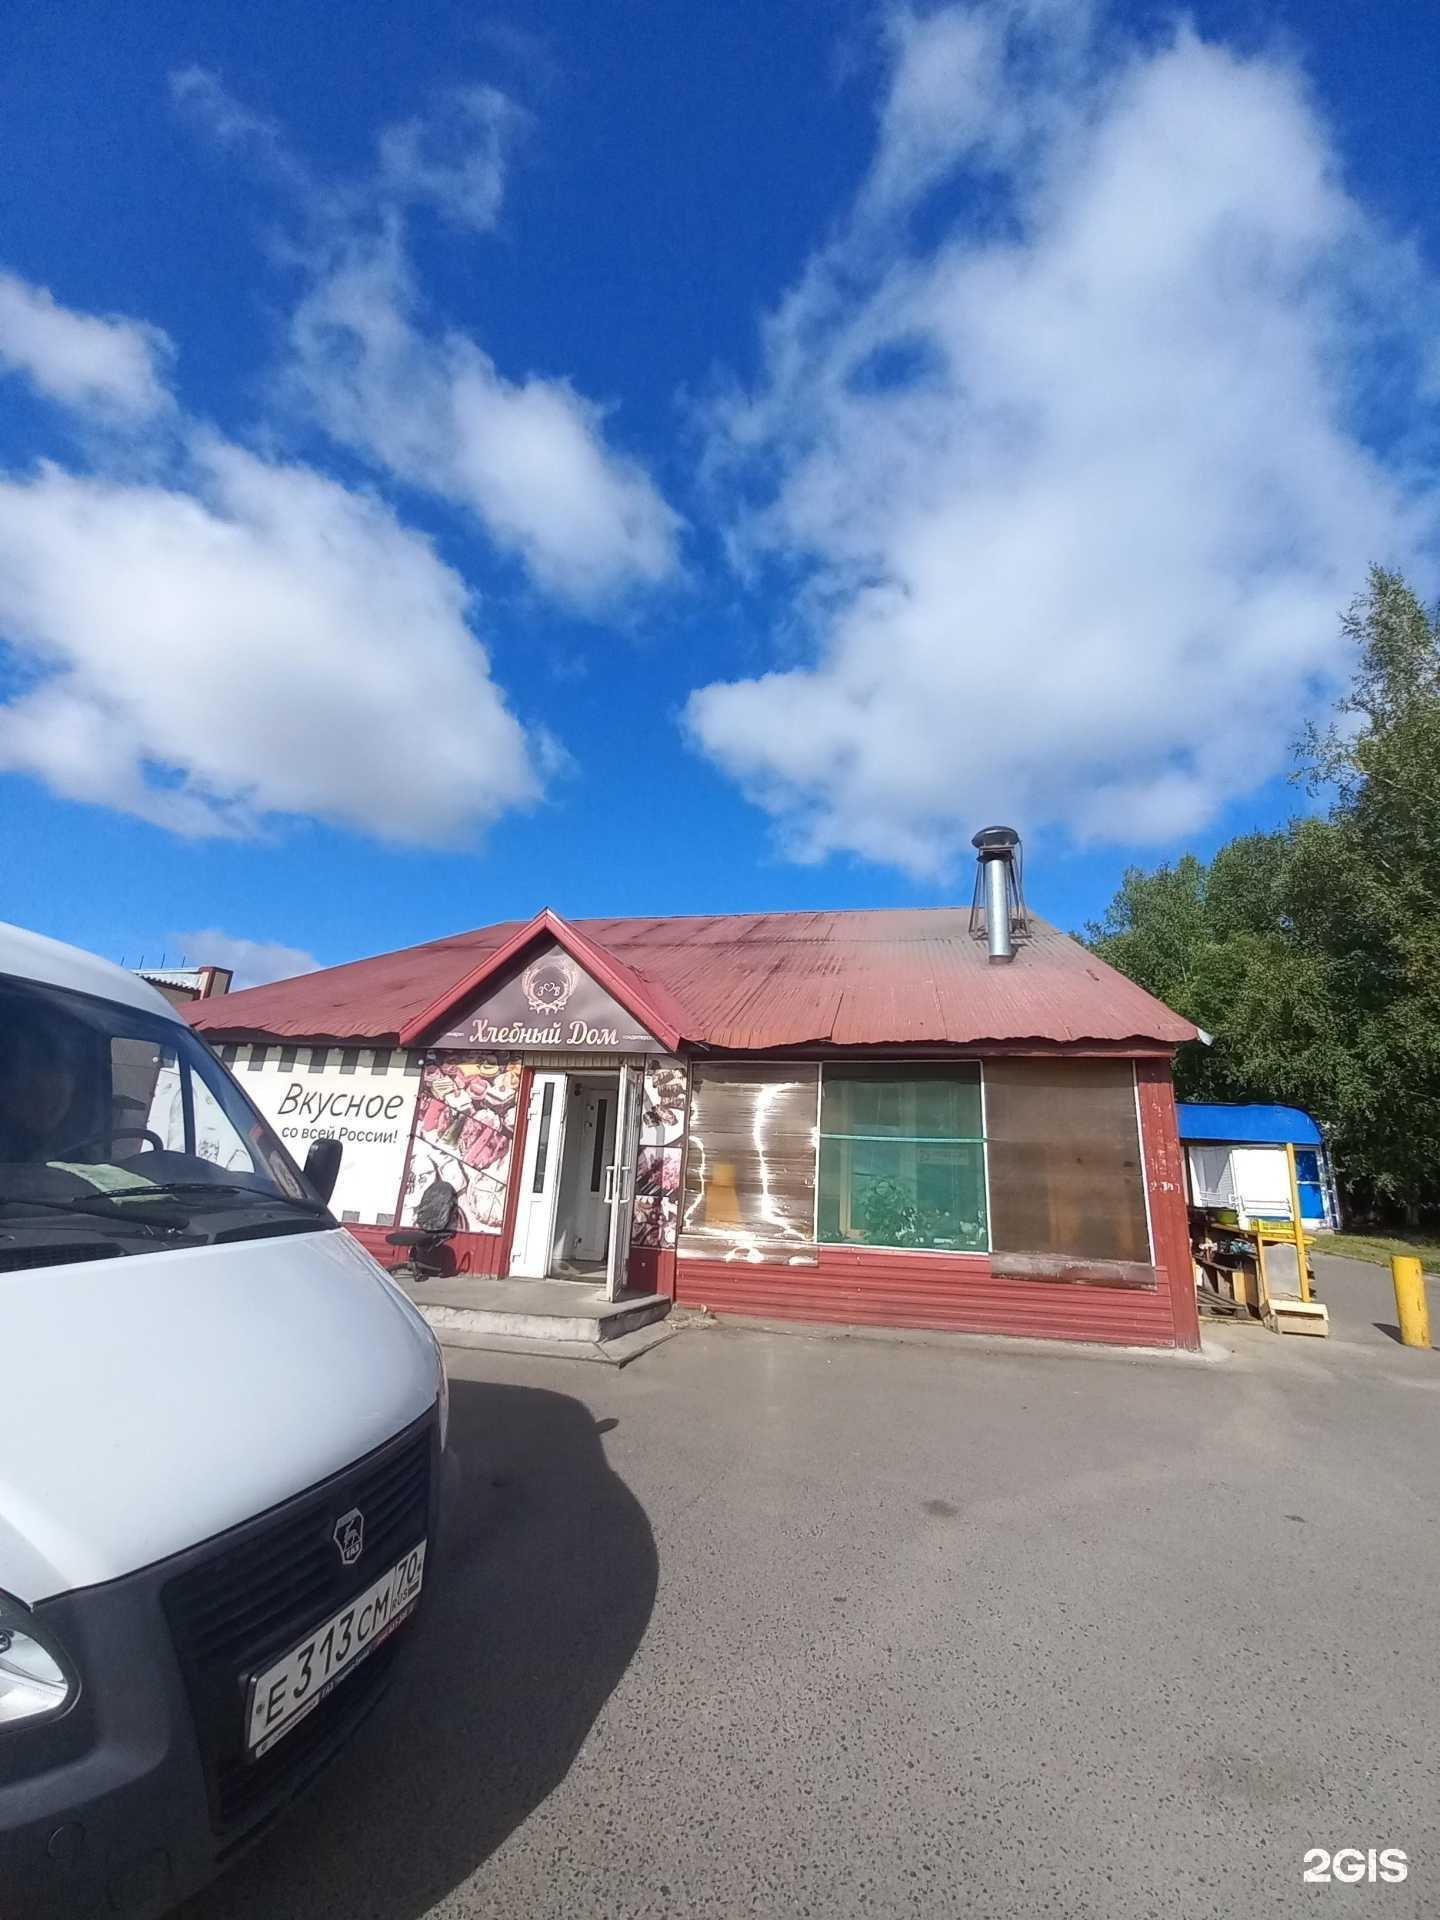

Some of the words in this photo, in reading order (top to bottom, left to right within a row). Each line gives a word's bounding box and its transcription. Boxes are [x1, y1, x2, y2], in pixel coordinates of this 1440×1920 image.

[469, 1019, 562, 1044] Хлебный
[566, 1020, 620, 1045] Дом
[277, 1083, 404, 1123] Вкусное
[281, 1127, 298, 1138] со
[301, 1126, 335, 1140] всей
[339, 1127, 398, 1144] России!
